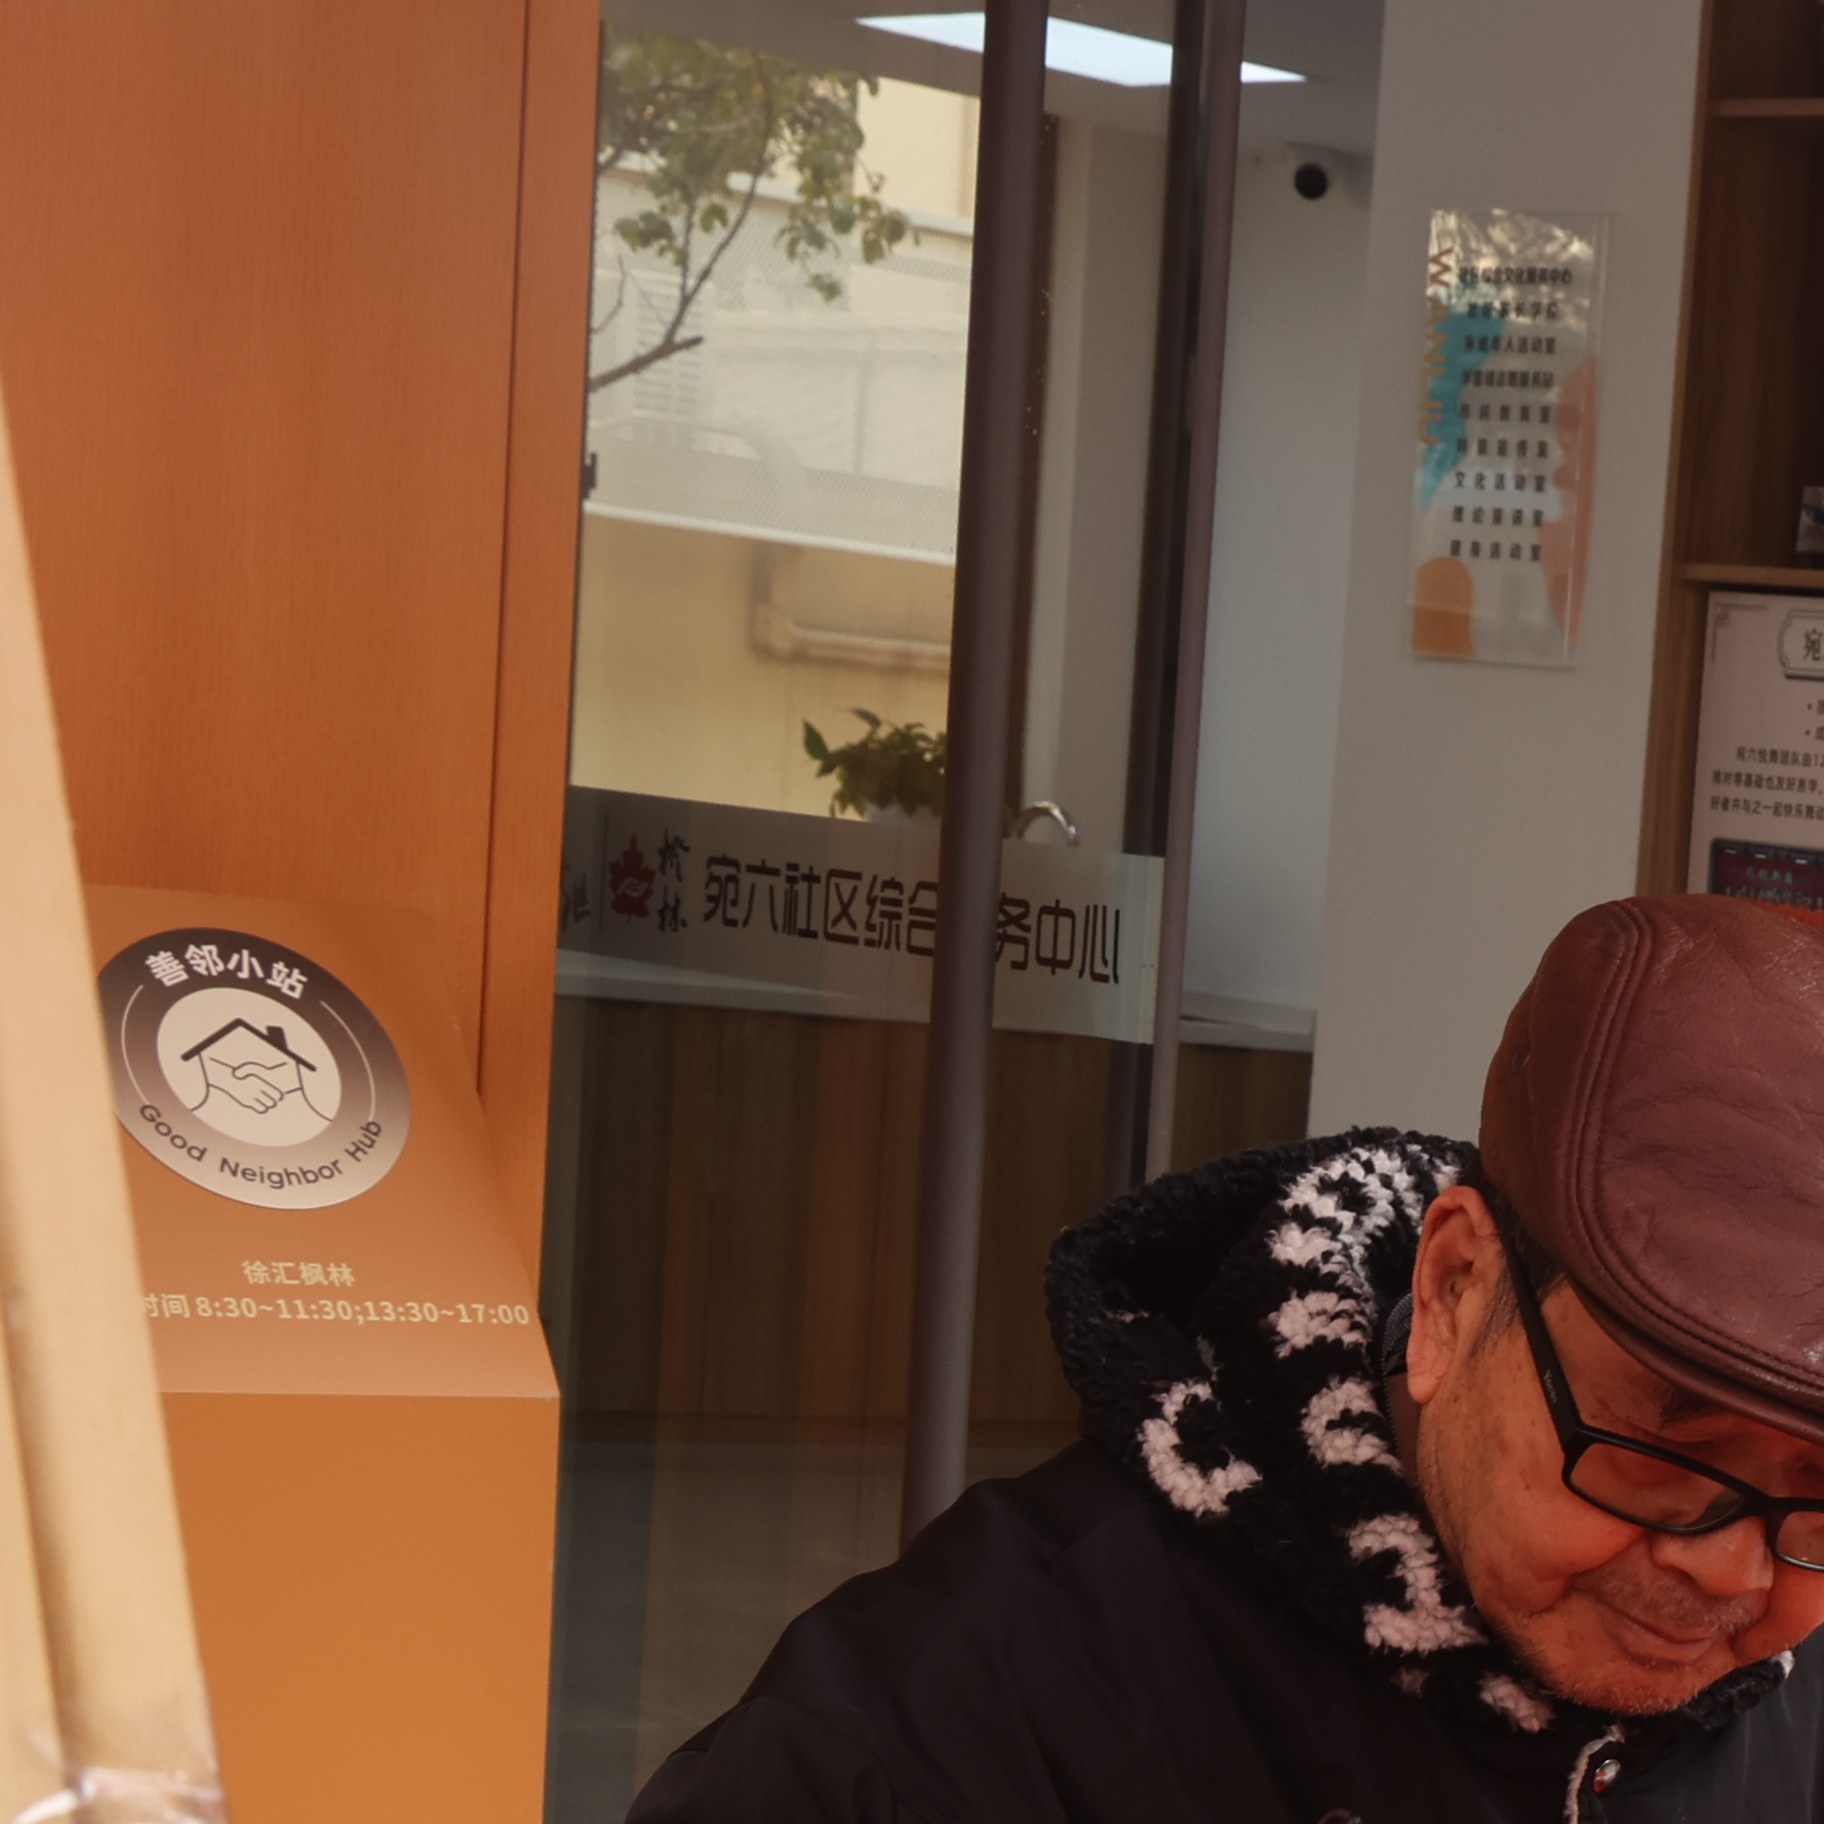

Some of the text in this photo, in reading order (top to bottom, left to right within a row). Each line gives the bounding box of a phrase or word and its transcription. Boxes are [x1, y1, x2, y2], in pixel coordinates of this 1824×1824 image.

[703, 854, 1121, 985] 宛六社区综合务中心
[145, 943, 309, 1000] 善邻小站
[139, 1102, 383, 1190] Good Neighbor Hub
[241, 1259, 355, 1288] 徐汇枫林
